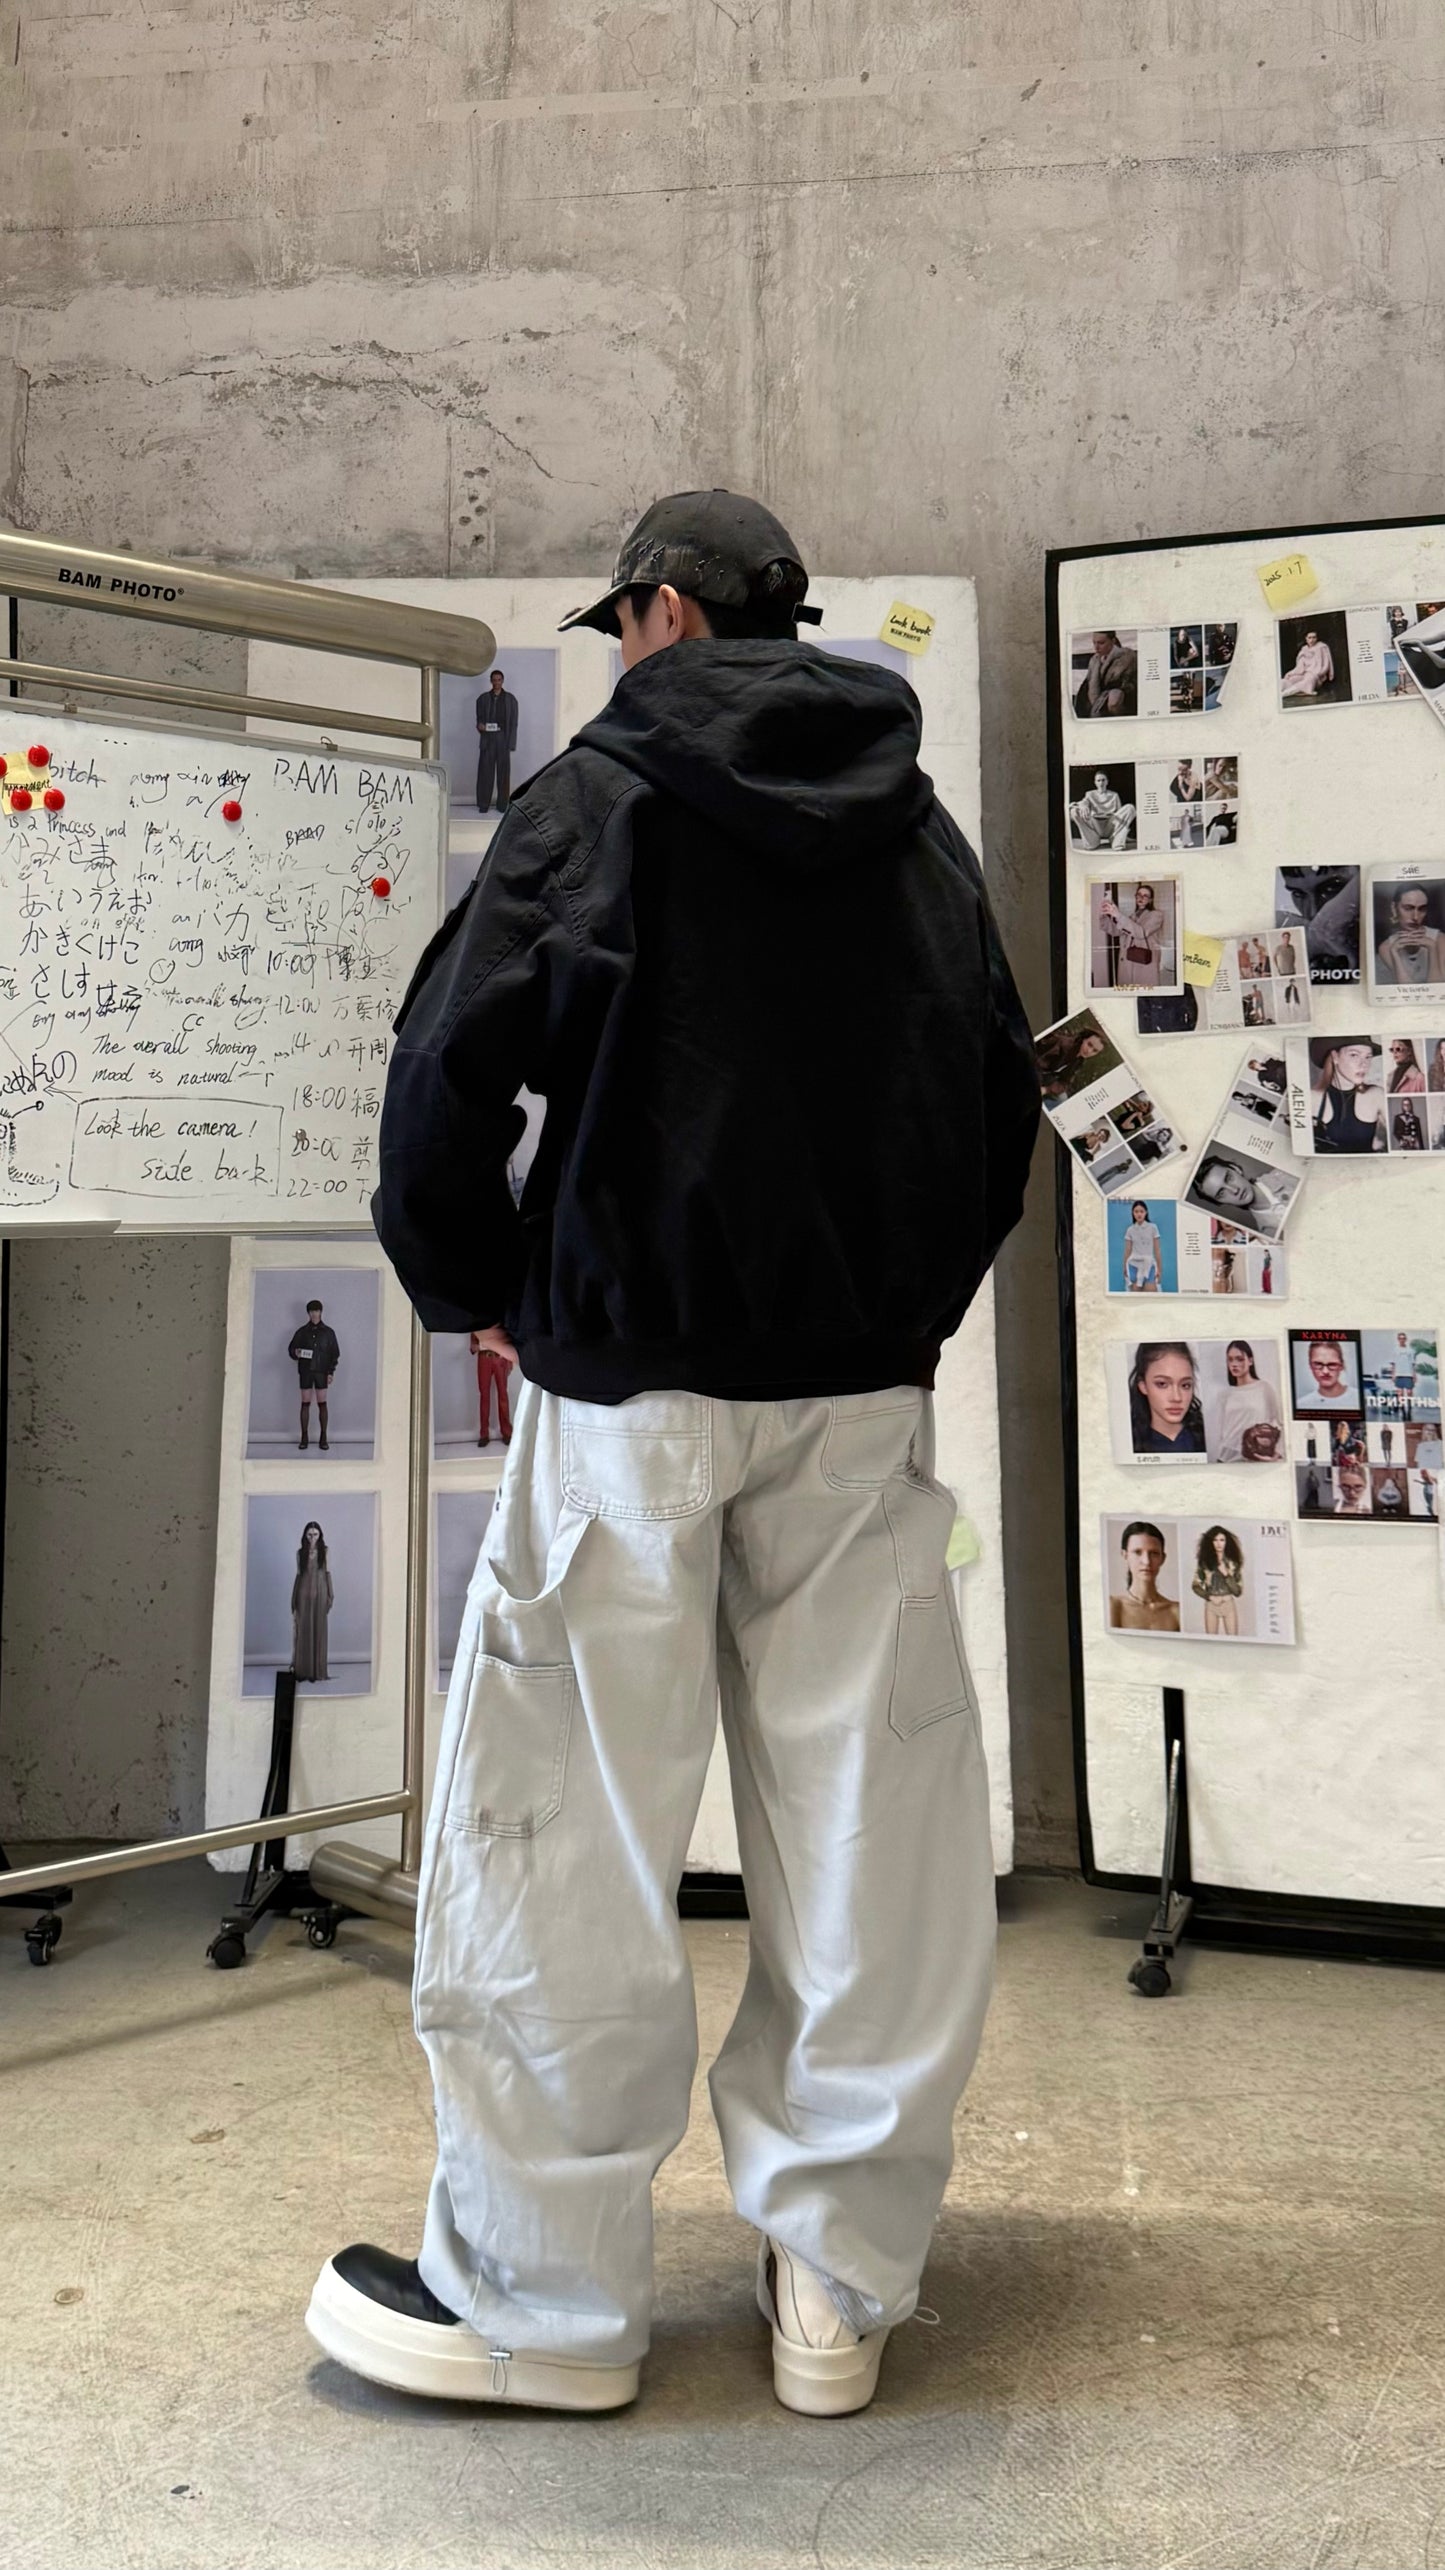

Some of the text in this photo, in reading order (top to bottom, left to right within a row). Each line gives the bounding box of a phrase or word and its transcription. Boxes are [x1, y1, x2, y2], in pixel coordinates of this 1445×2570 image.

[58, 568, 102, 589] BAM
[890, 614, 932, 636] Look book
[48, 753, 106, 789] bitch
[358, 769, 414, 805] BAM
[48, 810, 97, 839] Princess
[105, 820, 127, 838] and
[19, 882, 153, 919] あいうえお
[19, 920, 140, 965] かきくけこ
[92, 1031, 258, 1067] The overall shooting
[91, 1060, 239, 1087] mood is natural
[292, 1083, 347, 1112] 18:00
[1291, 1083, 1306, 1129] ALENA
[84, 1108, 123, 1139] Look
[128, 1108, 166, 1138] the
[140, 1149, 194, 1183] side
[286, 1178, 348, 1198] 22:00
[354, 1178, 374, 1205] 下
[1301, 1330, 1348, 1341] KARYNA
